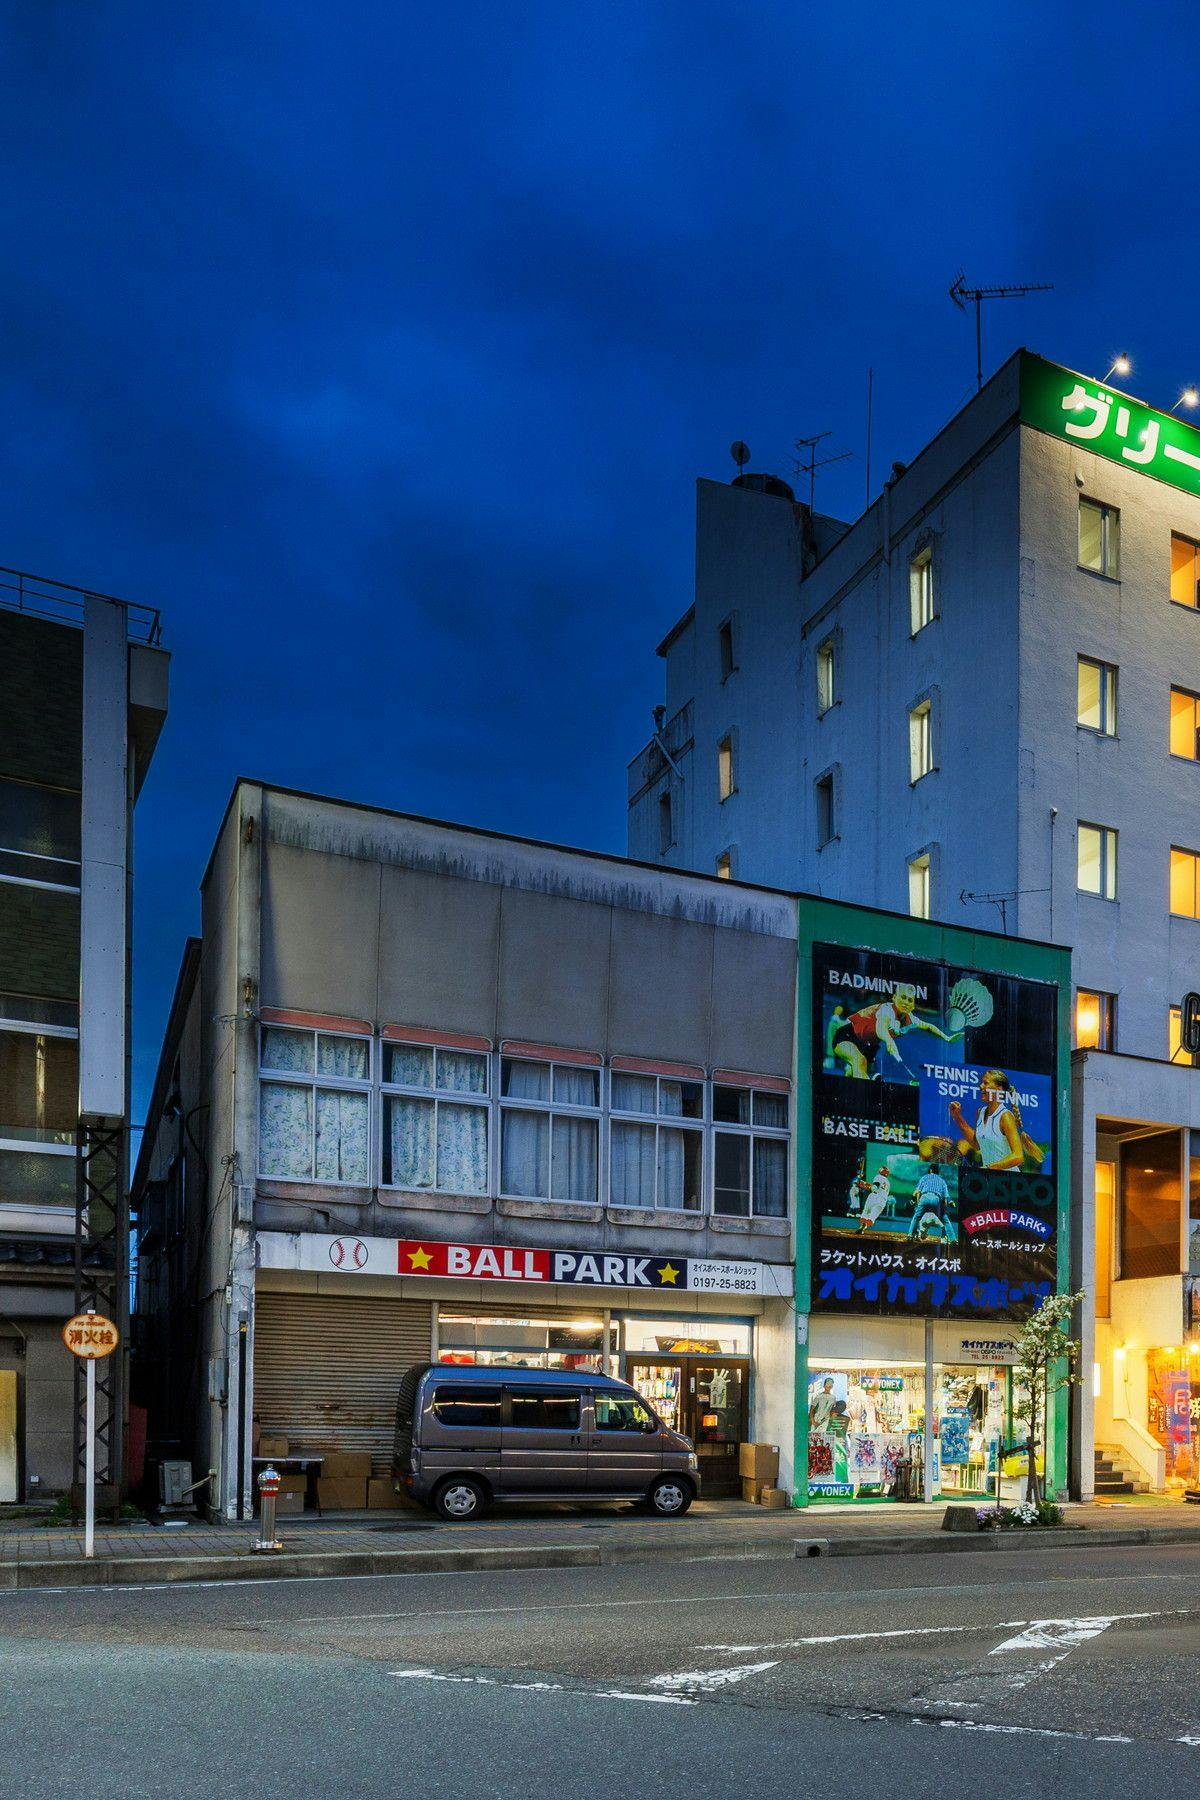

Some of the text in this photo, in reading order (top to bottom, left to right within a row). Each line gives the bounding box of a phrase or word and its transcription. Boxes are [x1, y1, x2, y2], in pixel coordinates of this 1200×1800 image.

[828, 969, 928, 1000] BADMINTON
[923, 1063, 979, 1084] TENNIS
[939, 1081, 1039, 1108] SOFT TENNIS
[823, 1120, 869, 1139] BASE
[976, 1212, 1042, 1233] BALL PARK
[971, 1238, 1045, 1253] ベースボールショップ
[447, 1246, 653, 1285] BALL PARK
[693, 1277, 757, 1291] 0197-25-8823
[69, 1330, 113, 1344] 消火栓
[820, 1486, 851, 1496] YONEX
